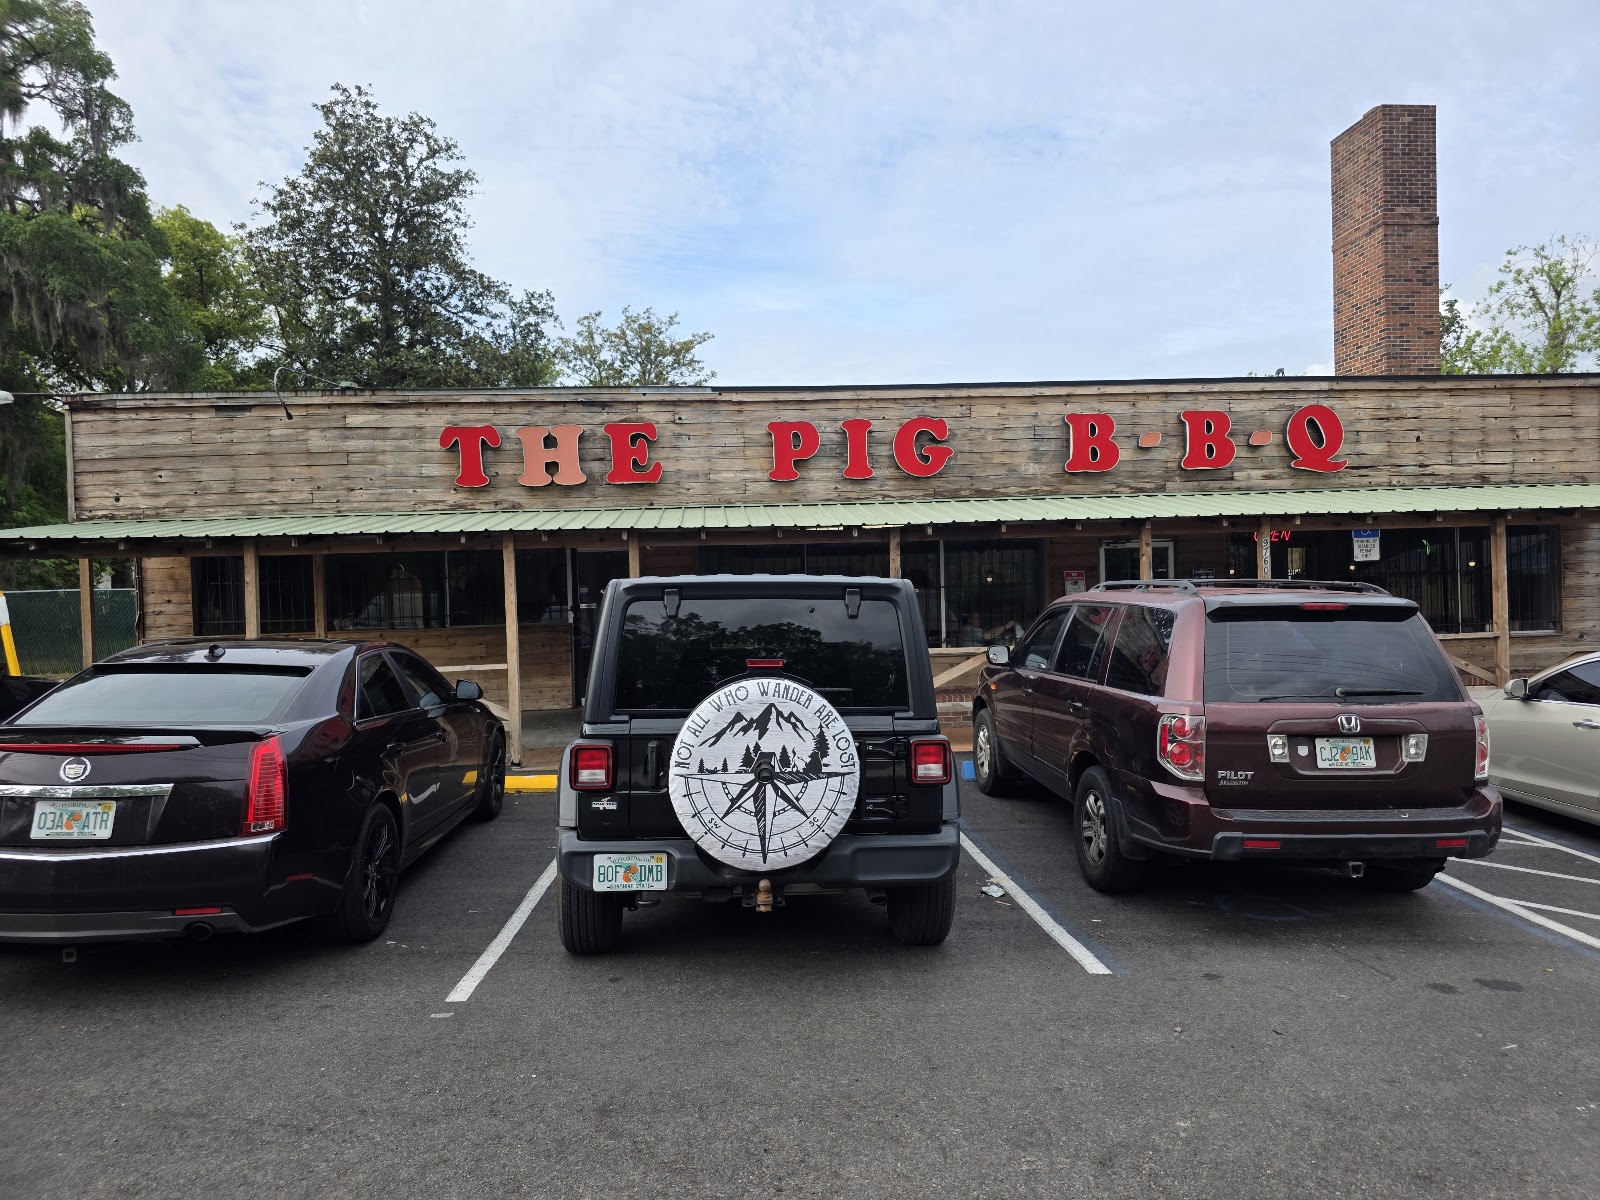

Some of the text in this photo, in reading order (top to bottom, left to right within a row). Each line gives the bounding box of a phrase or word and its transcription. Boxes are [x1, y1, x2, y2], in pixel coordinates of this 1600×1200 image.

[438, 421, 663, 488] THE
[766, 416, 955, 481] PIG
[1253, 530, 1291, 541] EN
[1262, 537, 1270, 575] 9760
[674, 681, 856, 769] NOT ALL WHO WANDER ARE LOST
[1217, 770, 1255, 780] PILOT
[82, 811, 110, 830] ATR
[638, 864, 663, 882] DMB
